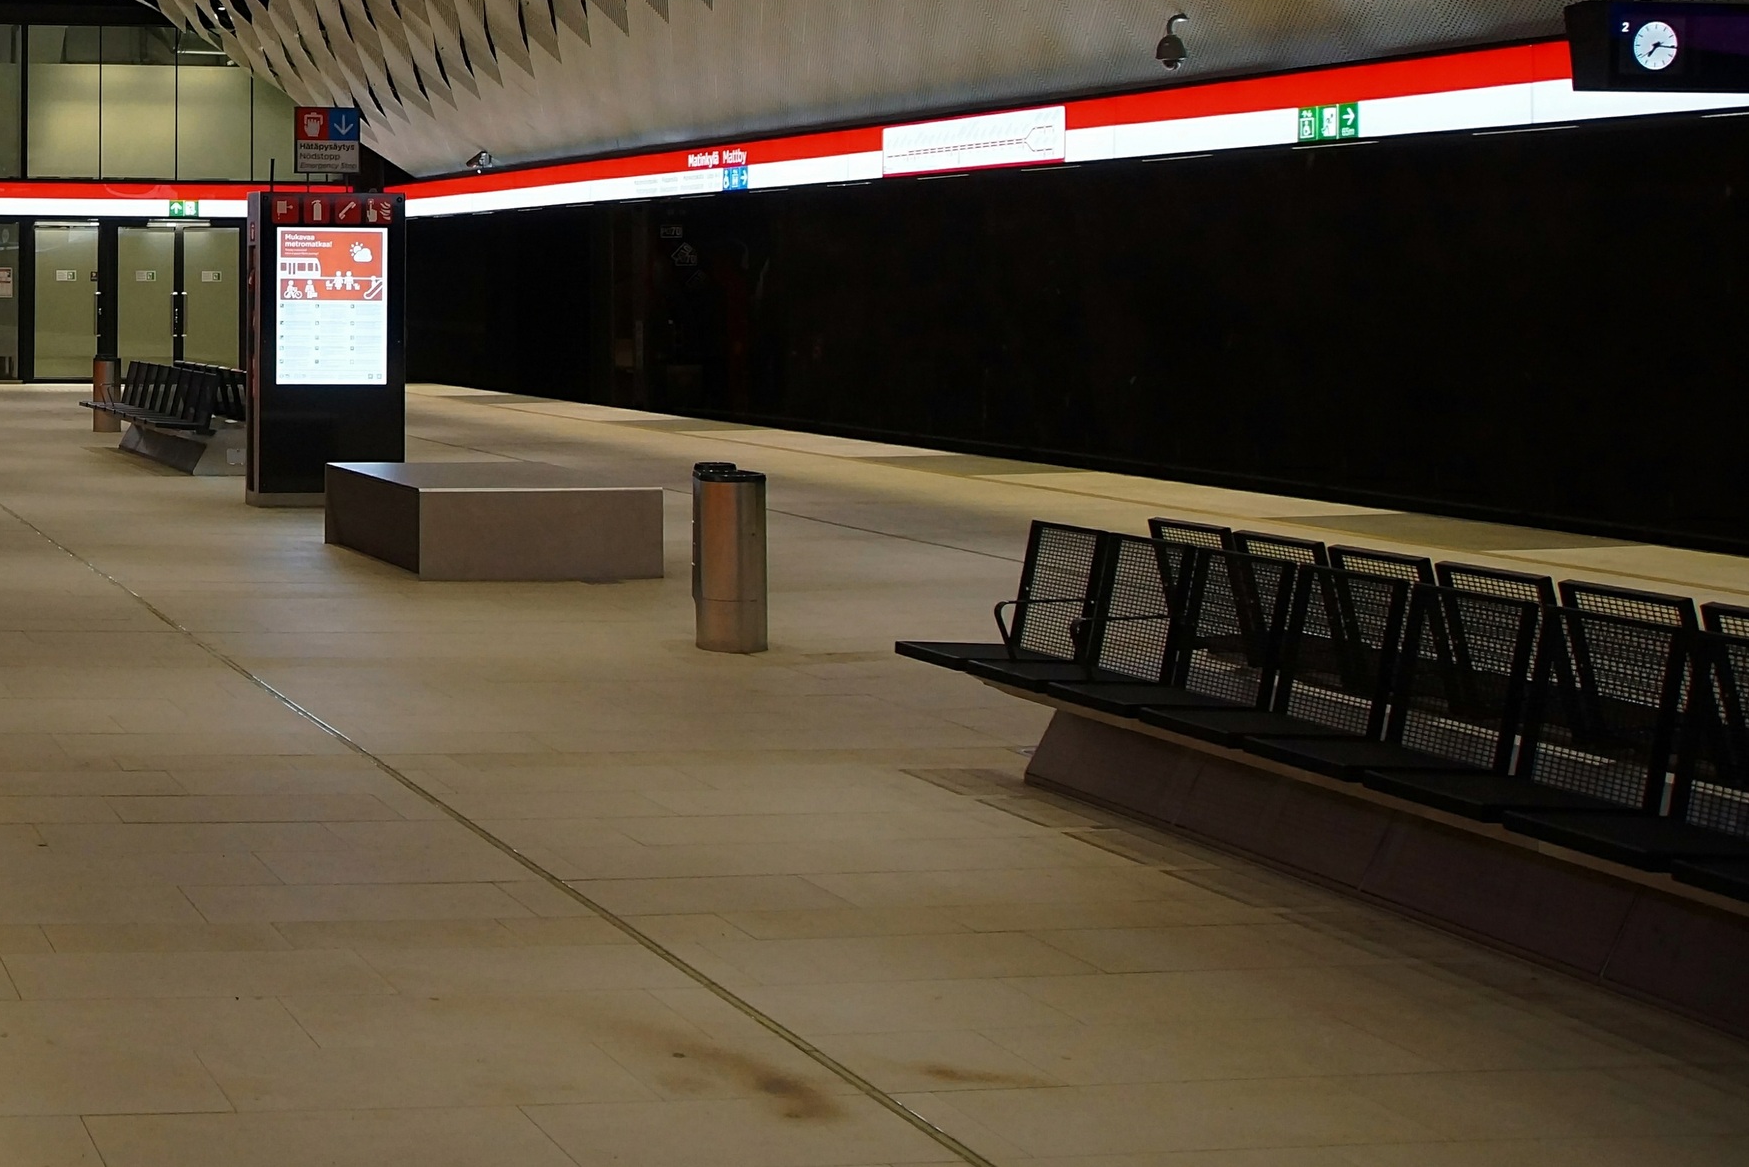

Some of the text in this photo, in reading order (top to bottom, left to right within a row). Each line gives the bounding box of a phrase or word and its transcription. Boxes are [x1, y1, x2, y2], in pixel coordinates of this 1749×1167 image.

[1621, 21, 1630, 33] 2
[299, 142, 355, 151] Hätäpysäytys
[687, 148, 748, 169] Matinkylä Mattby
[284, 233, 316, 241] Mukavaa
[284, 240, 333, 248] metromatkaa!
